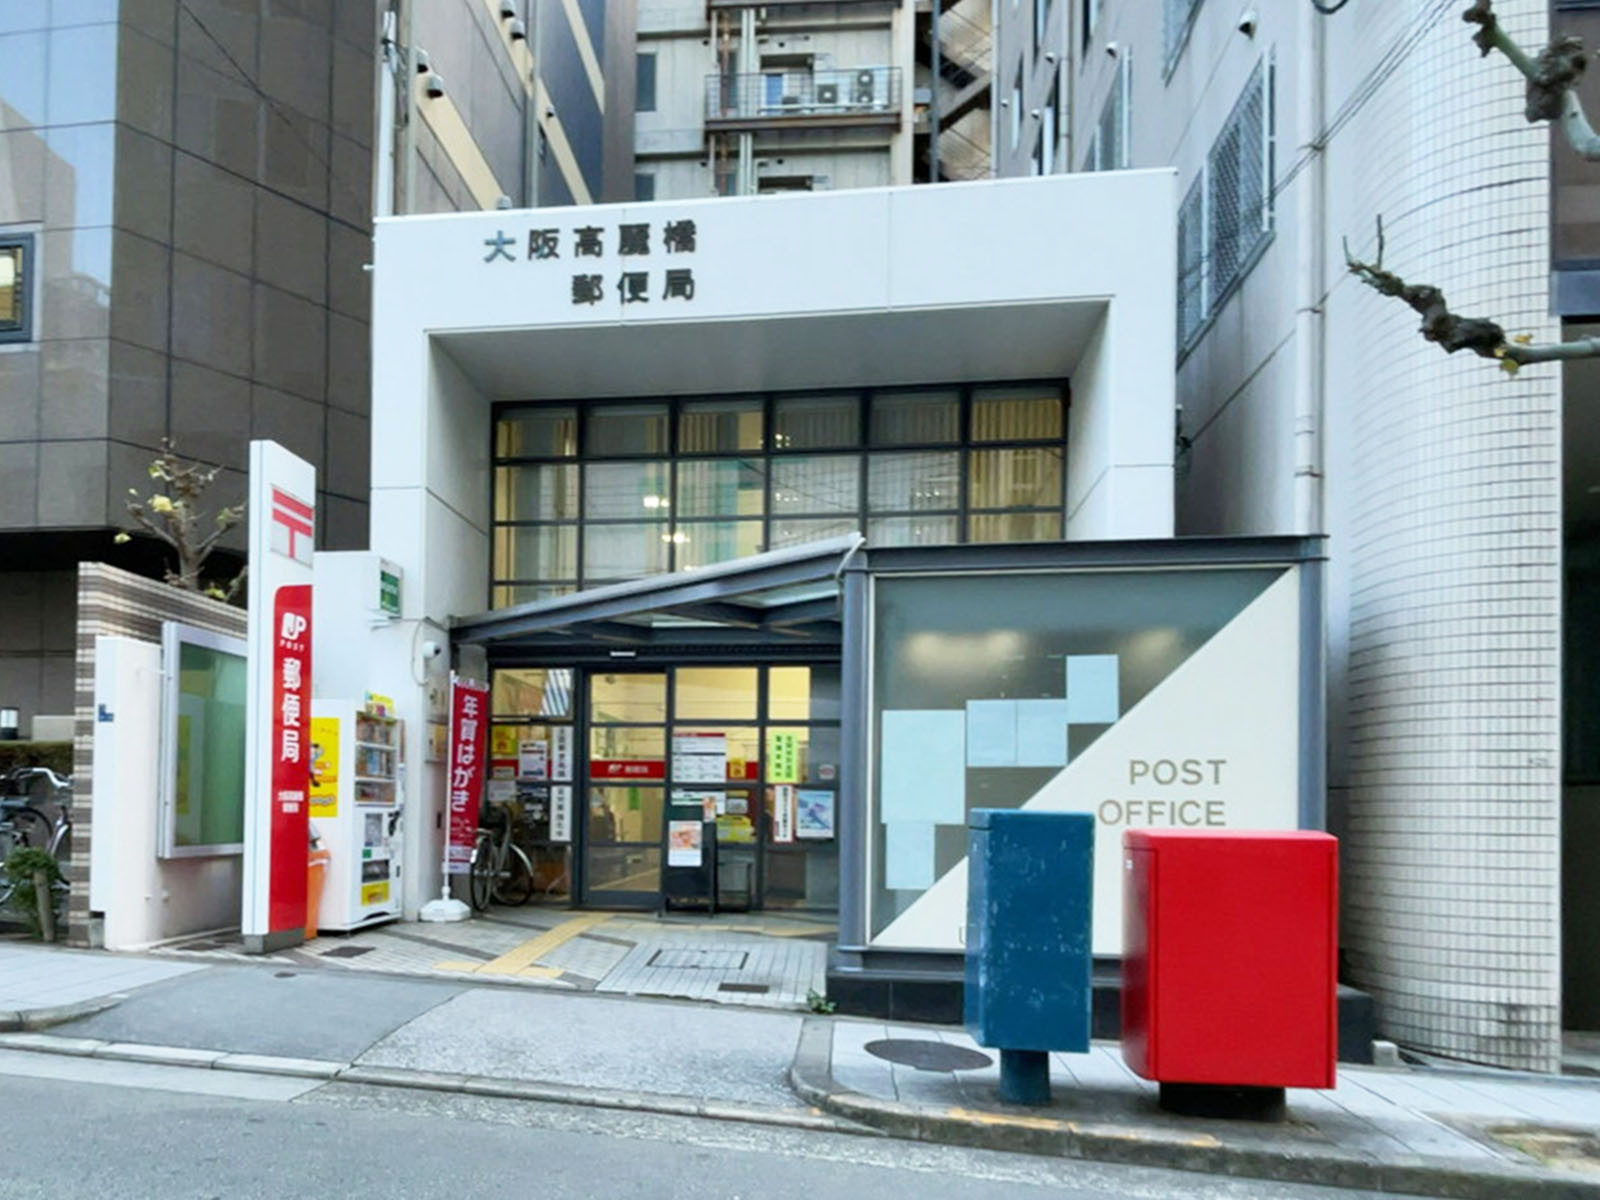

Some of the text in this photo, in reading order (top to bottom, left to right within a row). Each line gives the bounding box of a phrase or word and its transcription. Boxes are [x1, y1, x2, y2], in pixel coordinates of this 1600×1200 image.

[483, 219, 697, 264] 大阪高麗橋
[571, 268, 695, 306] 郵便局
[281, 657, 302, 763] 郵便局
[452, 695, 478, 813] 年賀はがき
[1129, 759, 1227, 785] POST
[1099, 799, 1226, 826] OFFICE
